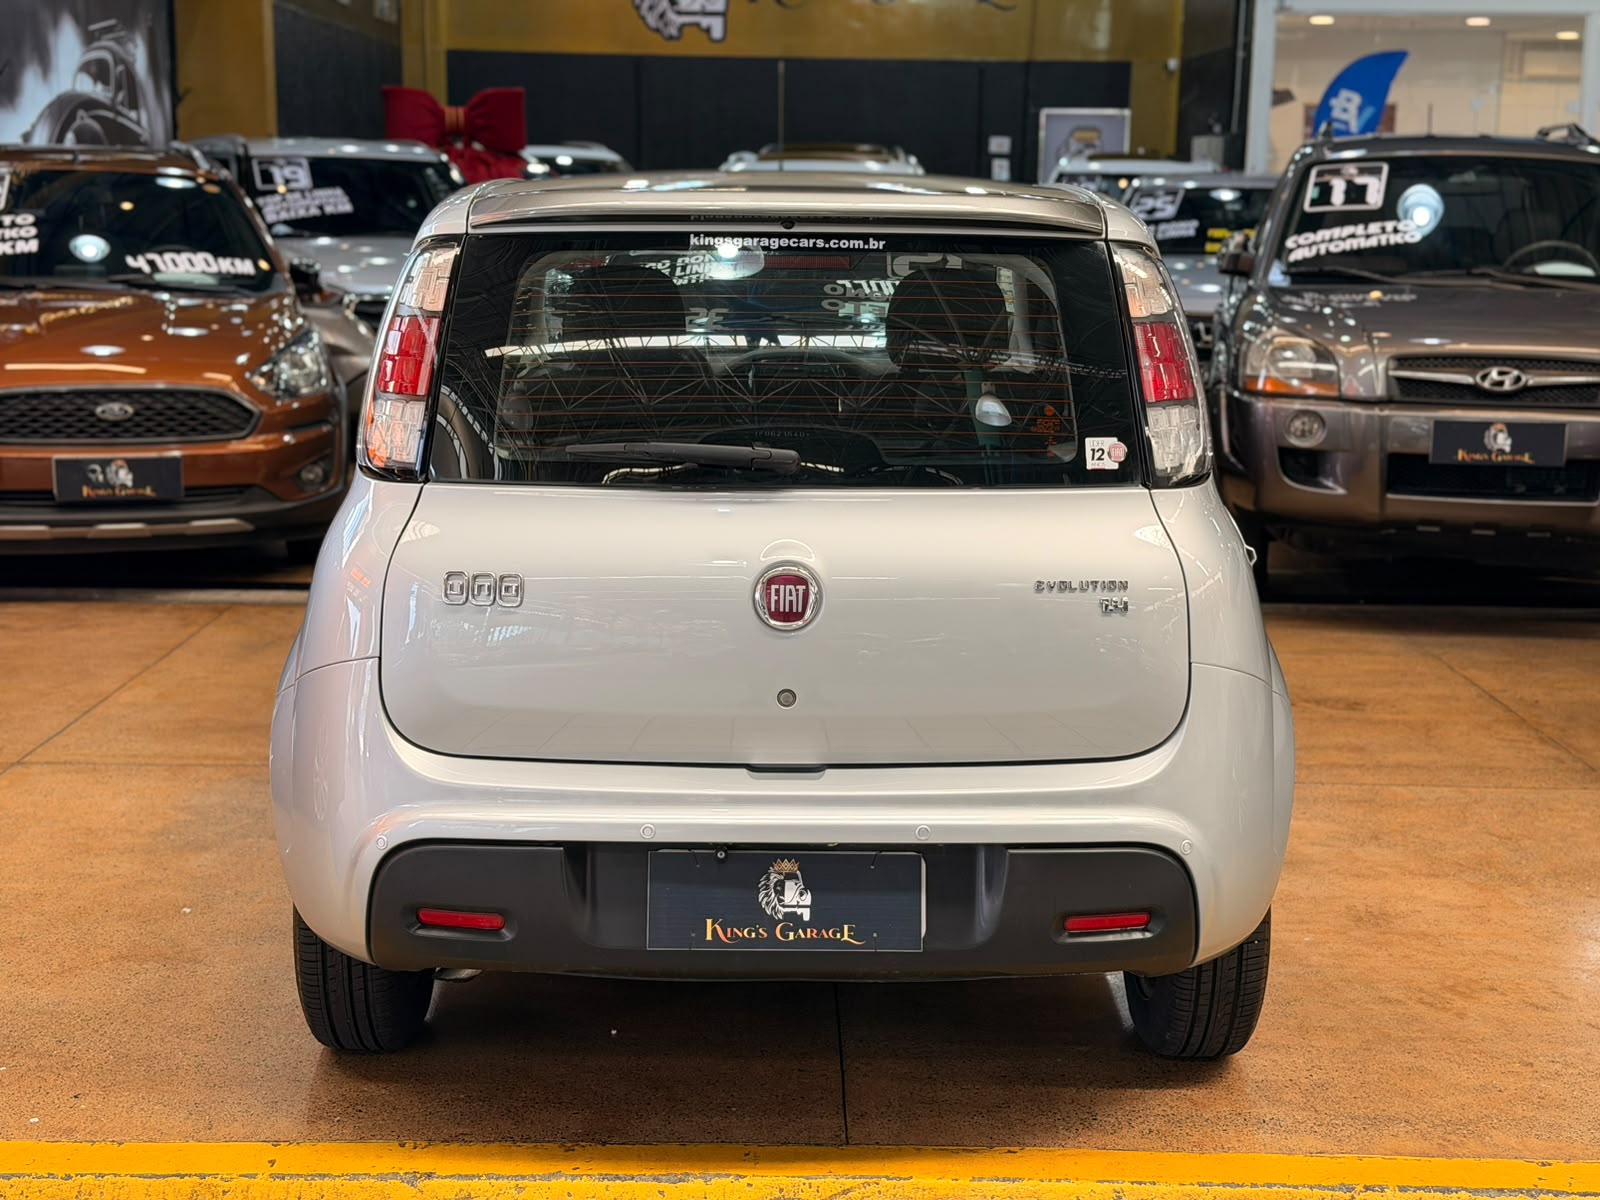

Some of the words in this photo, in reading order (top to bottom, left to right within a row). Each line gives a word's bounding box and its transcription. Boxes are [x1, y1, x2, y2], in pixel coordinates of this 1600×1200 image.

[689, 233, 887, 250] kingsgaragecars.com.br
[1285, 219, 1418, 249] COMPLETO
[1090, 447, 1105, 461] 12
[770, 584, 807, 613] FIAT
